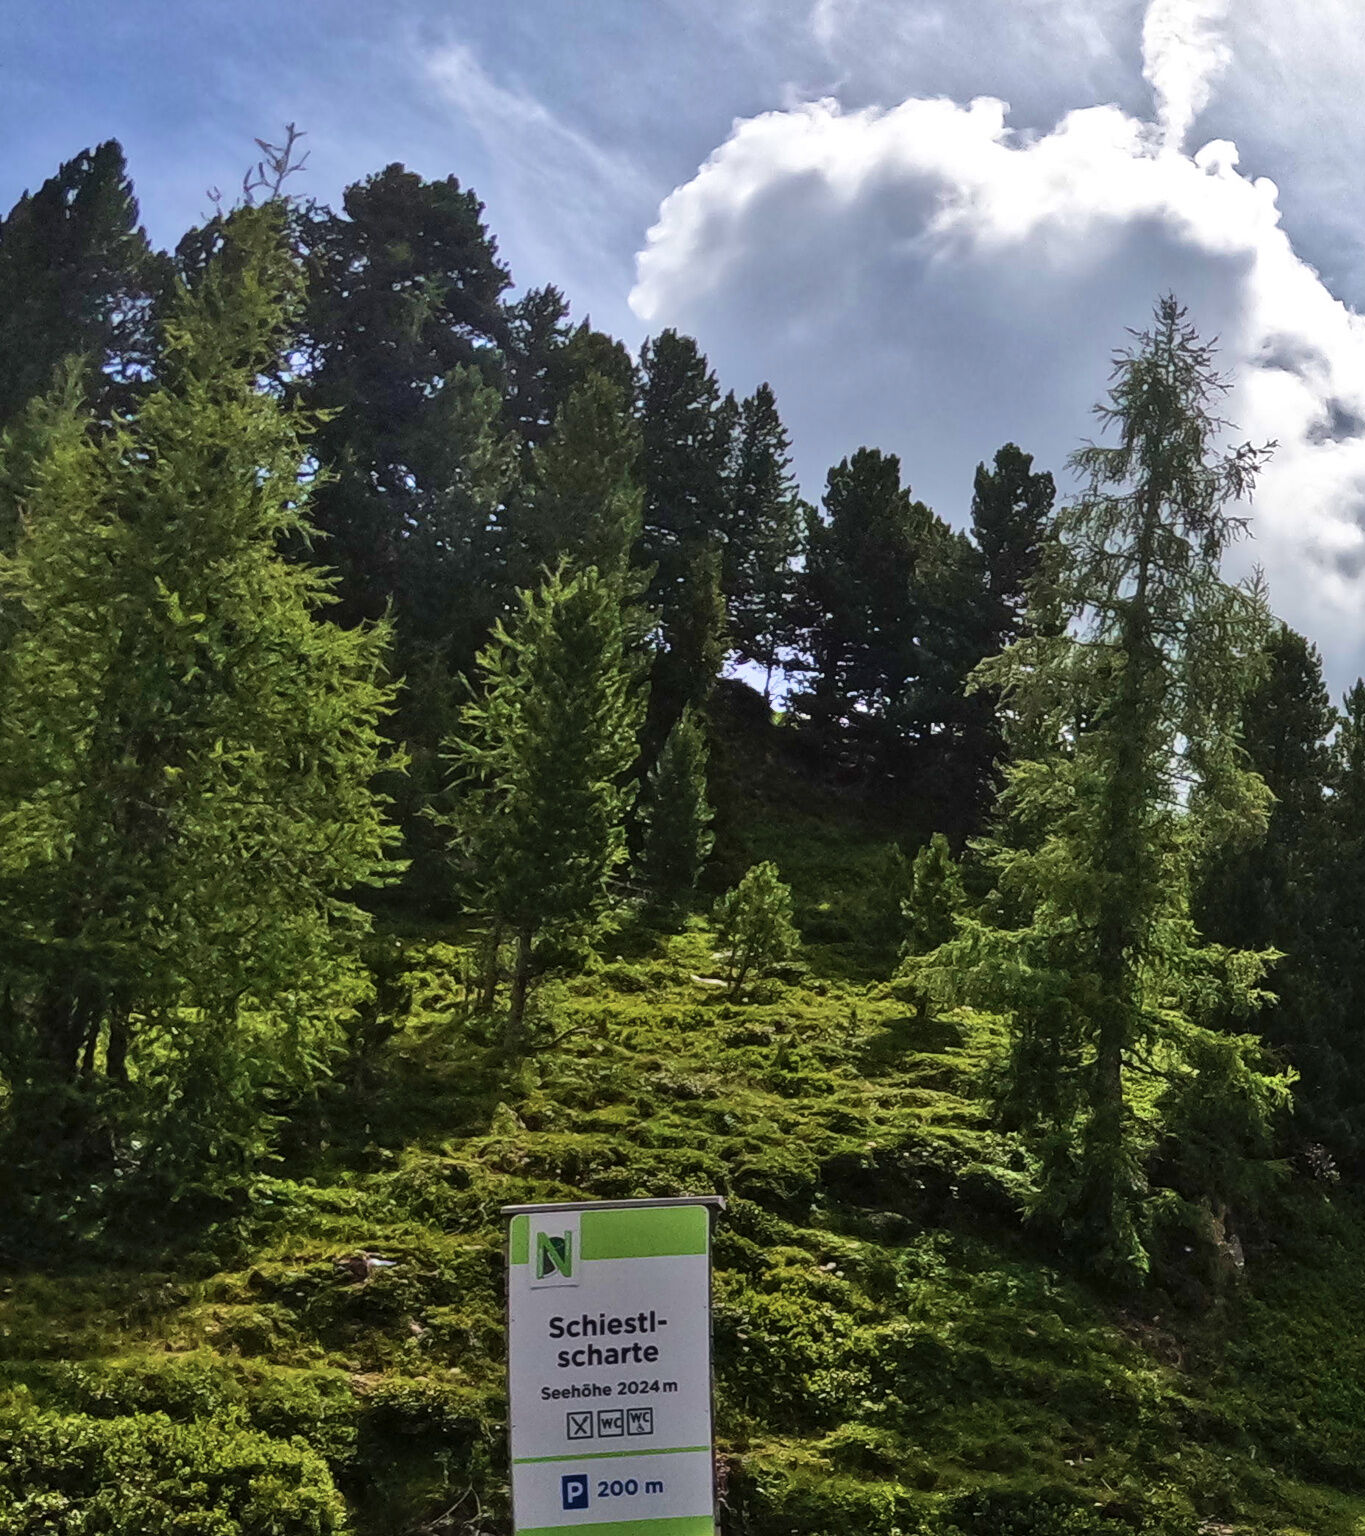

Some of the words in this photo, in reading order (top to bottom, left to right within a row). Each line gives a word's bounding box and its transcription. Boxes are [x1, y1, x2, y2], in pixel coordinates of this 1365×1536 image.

[549, 1310, 668, 1339] Schiestl-
[557, 1342, 659, 1368] scharte
[541, 1383, 612, 1400] Seehöhe
[617, 1380, 660, 1396] 2024
[662, 1381, 678, 1393] m
[601, 1417, 622, 1430] WC
[630, 1411, 650, 1424] WC
[567, 1481, 584, 1504] P
[597, 1479, 638, 1498] 200
[645, 1480, 664, 1494] m
